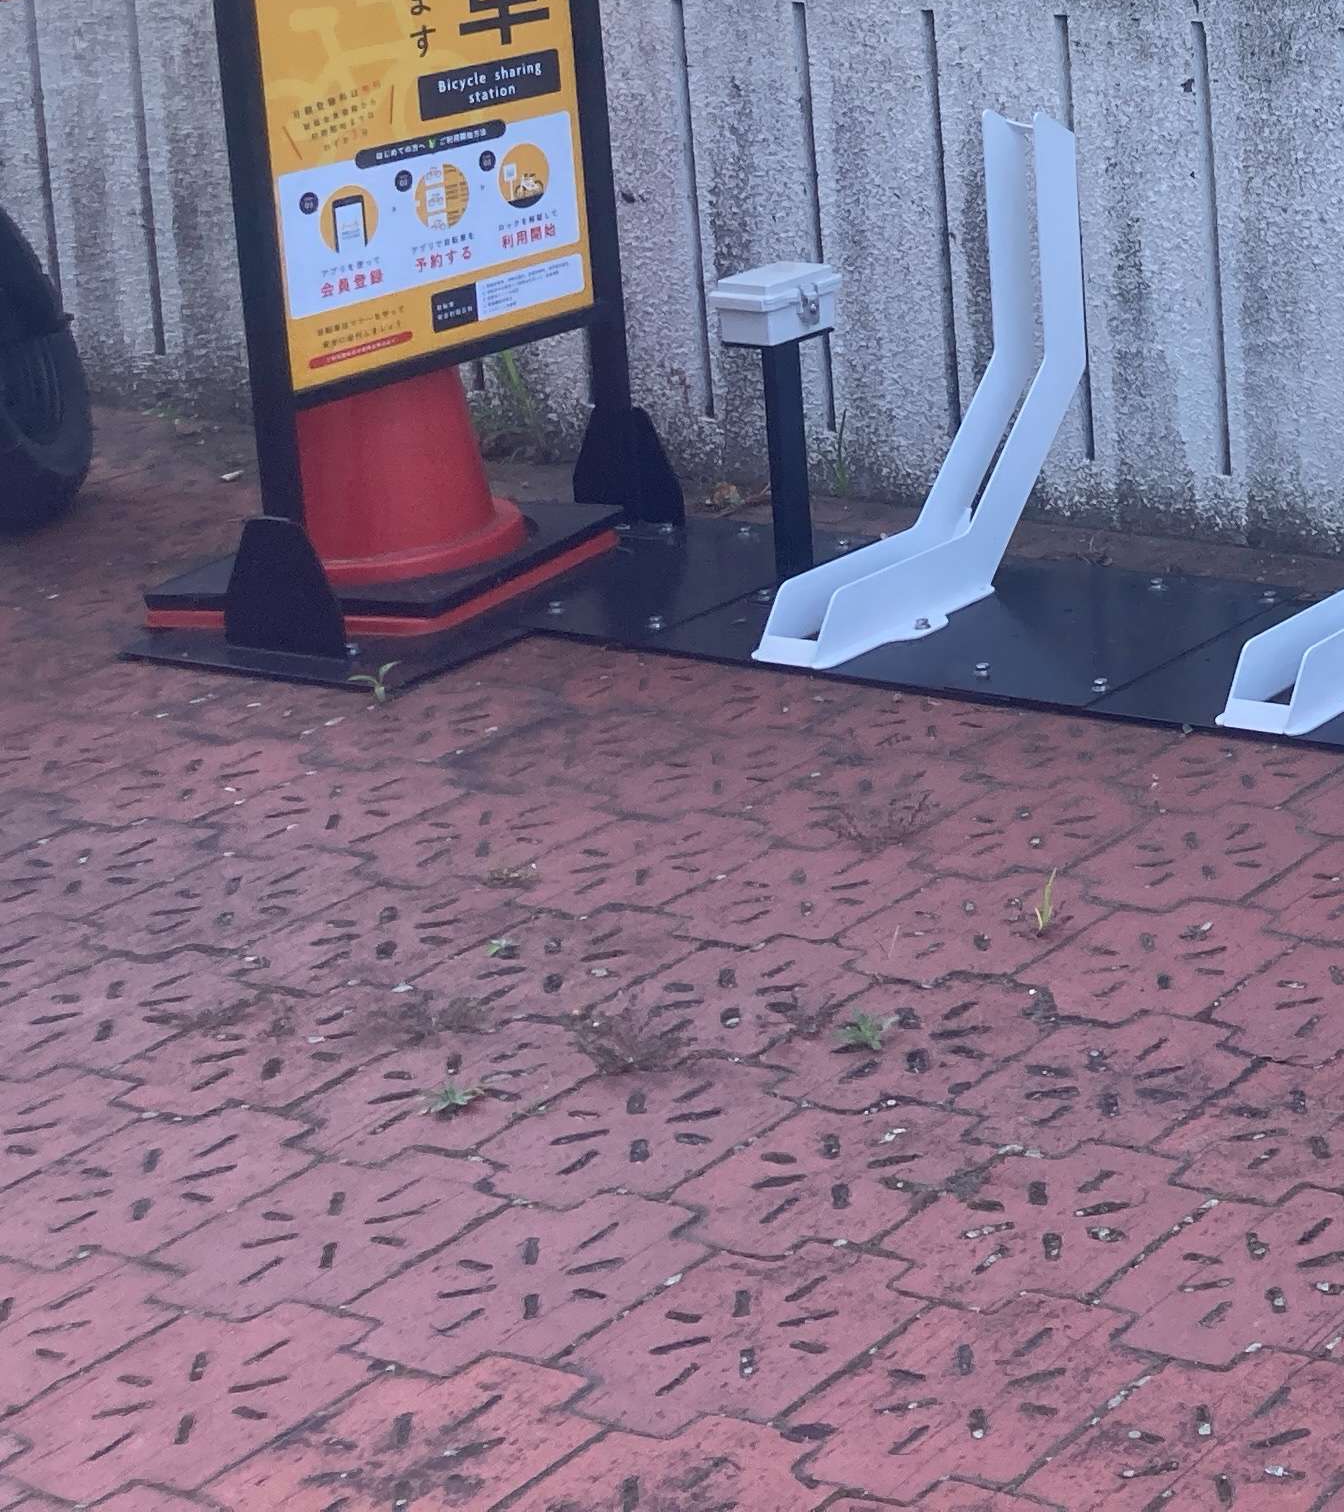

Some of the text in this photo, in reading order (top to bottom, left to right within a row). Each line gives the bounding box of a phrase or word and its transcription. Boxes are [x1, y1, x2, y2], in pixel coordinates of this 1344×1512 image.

[438, 62, 542, 93] Bicycle sharing
[469, 84, 516, 104] station
[502, 223, 556, 249] 利用開始
[416, 246, 472, 273] 予約する
[320, 269, 384, 298] 会員登録
